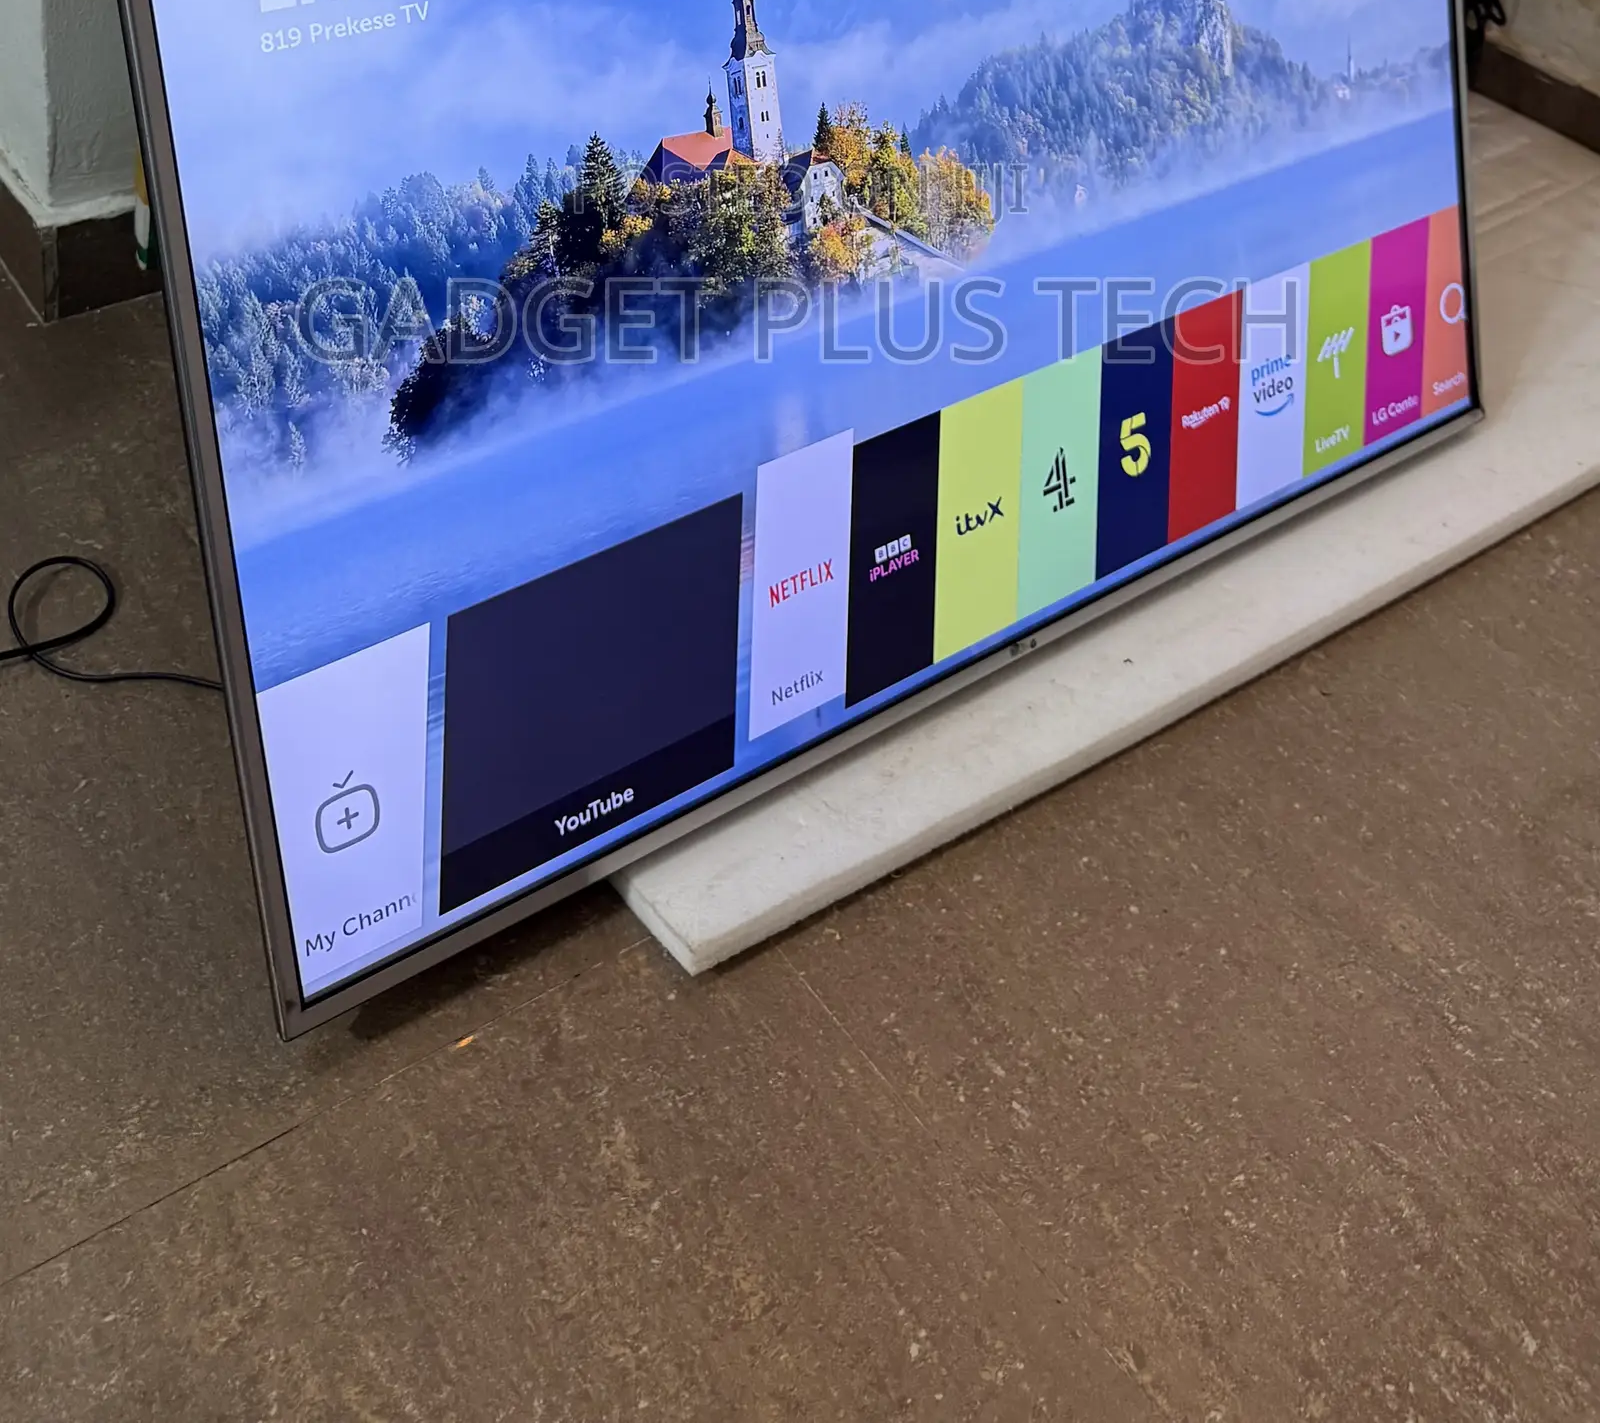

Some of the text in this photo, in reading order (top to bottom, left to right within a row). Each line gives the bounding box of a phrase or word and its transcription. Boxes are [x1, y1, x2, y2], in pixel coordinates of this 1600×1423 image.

[260, 1, 429, 53] 819 Prekese TV
[1250, 353, 1292, 387] prime
[1252, 377, 1294, 404] video
[1371, 407, 1388, 426] LG
[1119, 412, 1152, 477] 5
[768, 559, 834, 608] NETFLIX
[771, 669, 824, 706] Netflix
[554, 786, 634, 837] YouTube
[305, 928, 336, 958] My
